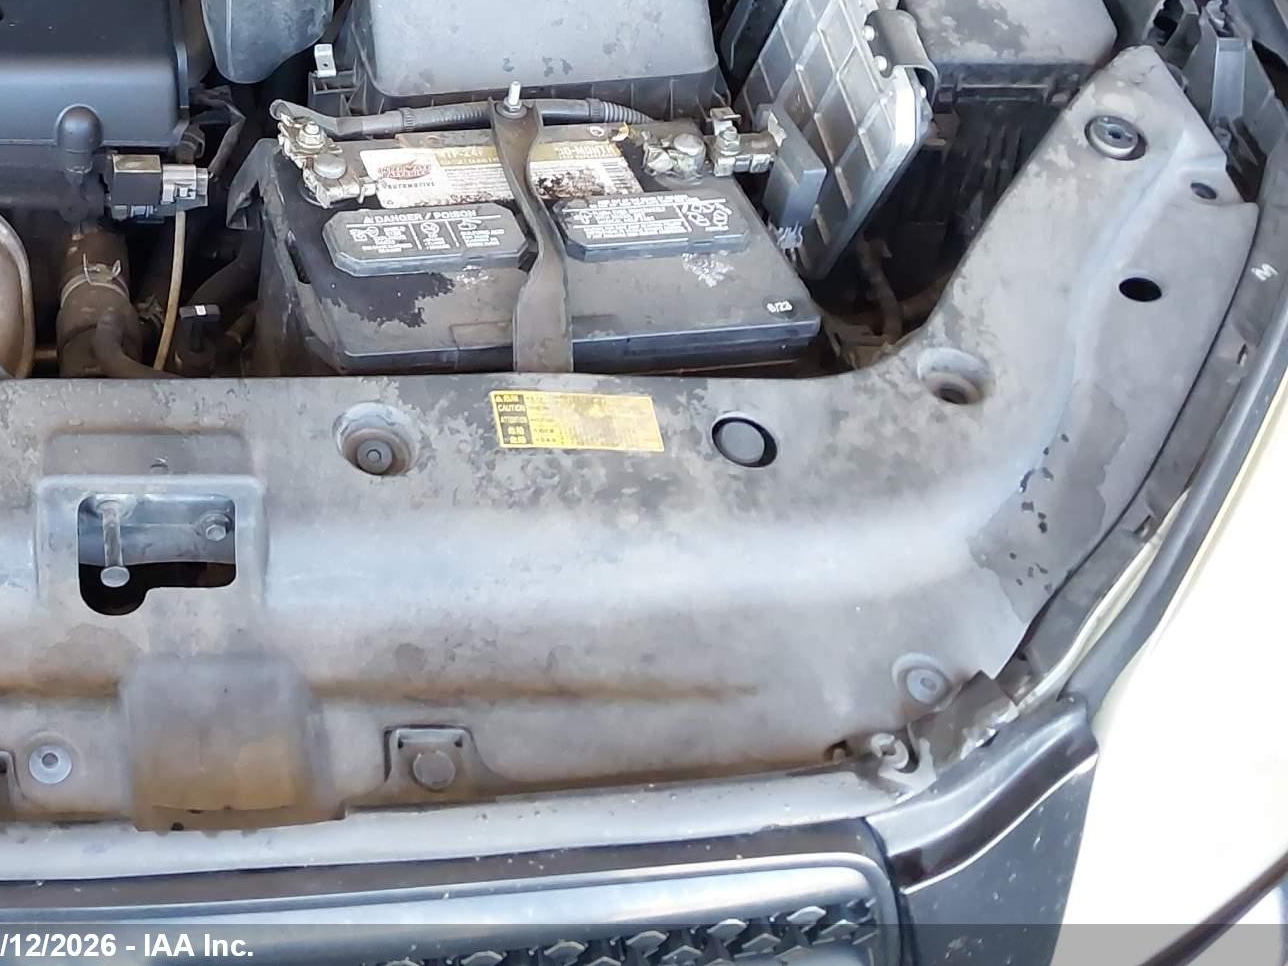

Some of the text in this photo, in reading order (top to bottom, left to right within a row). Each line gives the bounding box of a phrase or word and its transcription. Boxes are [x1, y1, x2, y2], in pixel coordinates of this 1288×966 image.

[375, 212, 423, 223] DANGER
[434, 209, 477, 220] POISON
[497, 403, 526, 412] CAUTION
